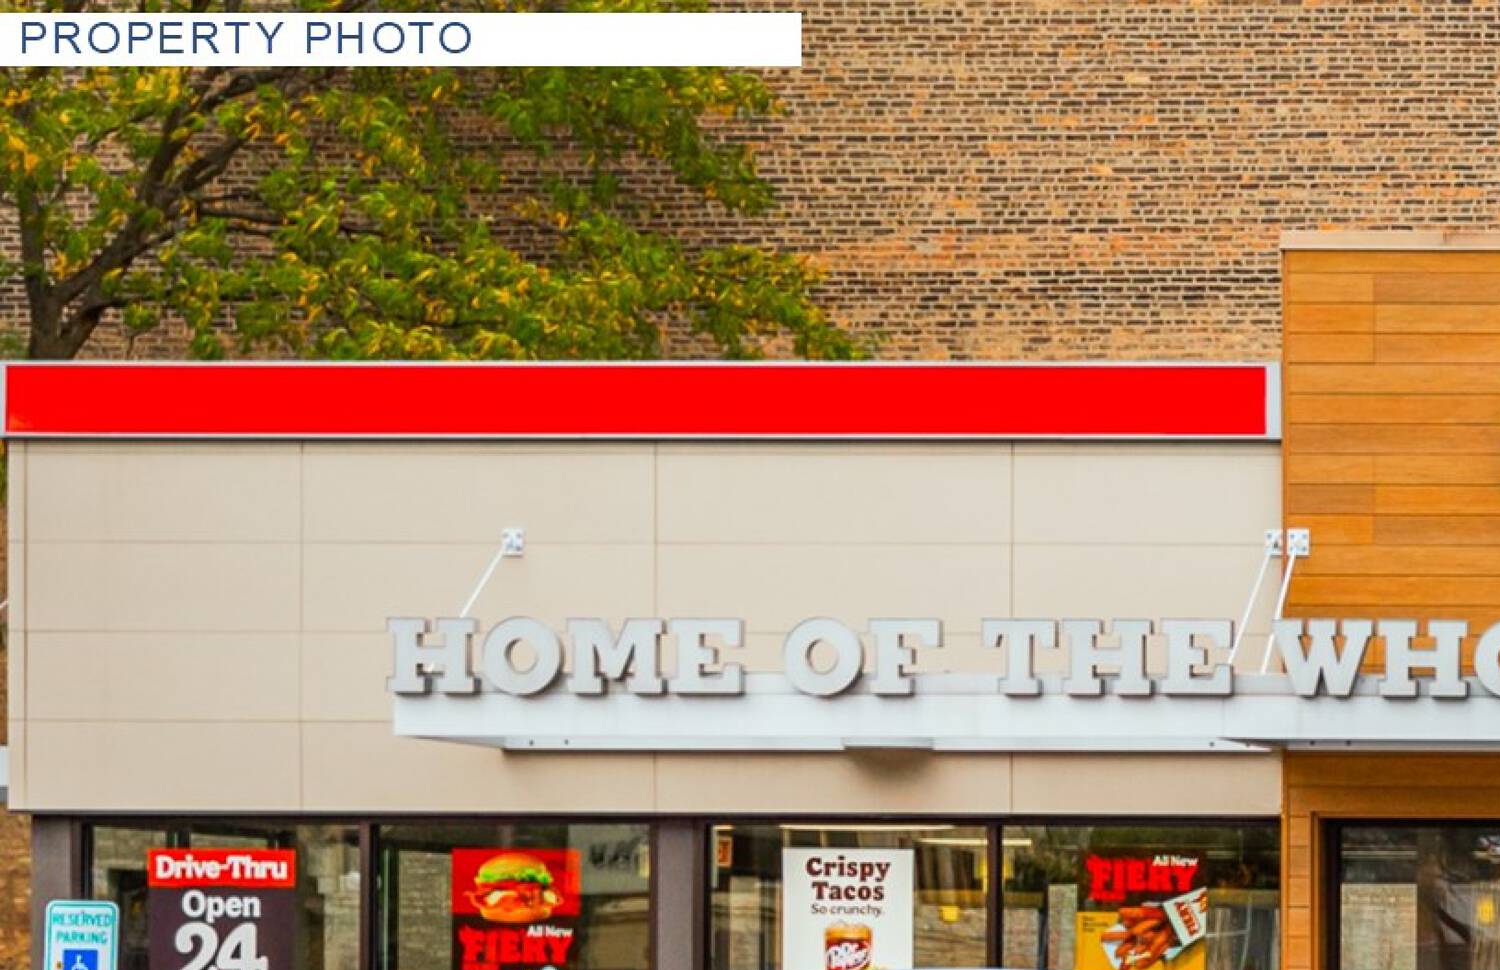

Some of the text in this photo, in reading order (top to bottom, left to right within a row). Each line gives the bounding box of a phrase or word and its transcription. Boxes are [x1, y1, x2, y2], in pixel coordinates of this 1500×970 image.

[386, 616, 745, 697] HOME
[783, 616, 943, 697] OF
[981, 617, 1234, 697] THE
[155, 853, 289, 880] Drive-Thru
[806, 855, 891, 882] Crispy
[811, 881, 885, 901] Tacos
[181, 889, 262, 922] Open
[811, 903, 828, 914] So
[52, 911, 113, 926] RESERVED
[57, 930, 108, 944] PARKING
[526, 924, 574, 938] All New
